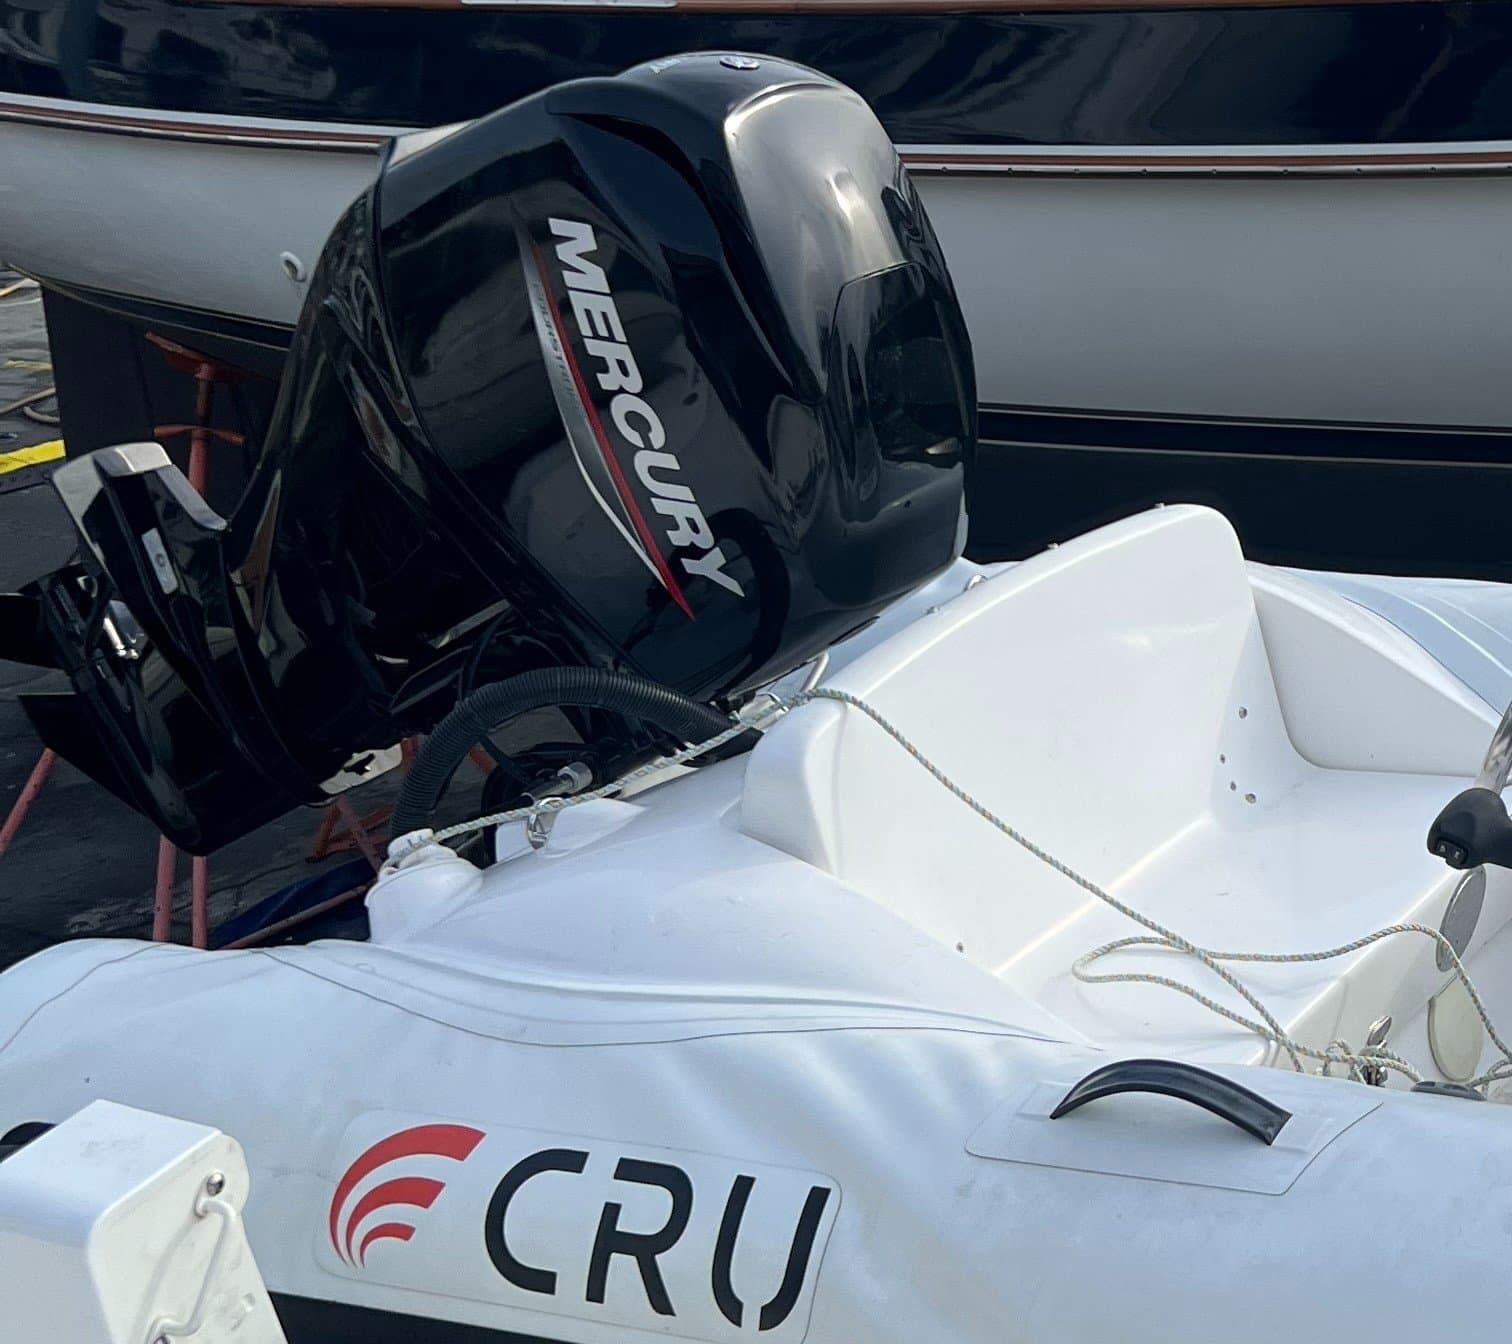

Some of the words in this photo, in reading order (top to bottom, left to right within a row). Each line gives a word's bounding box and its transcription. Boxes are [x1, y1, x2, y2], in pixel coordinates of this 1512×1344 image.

[531, 278, 582, 410] FOURSTRO
[548, 217, 745, 597] MERCURY
[484, 1148, 832, 1332] CRU
